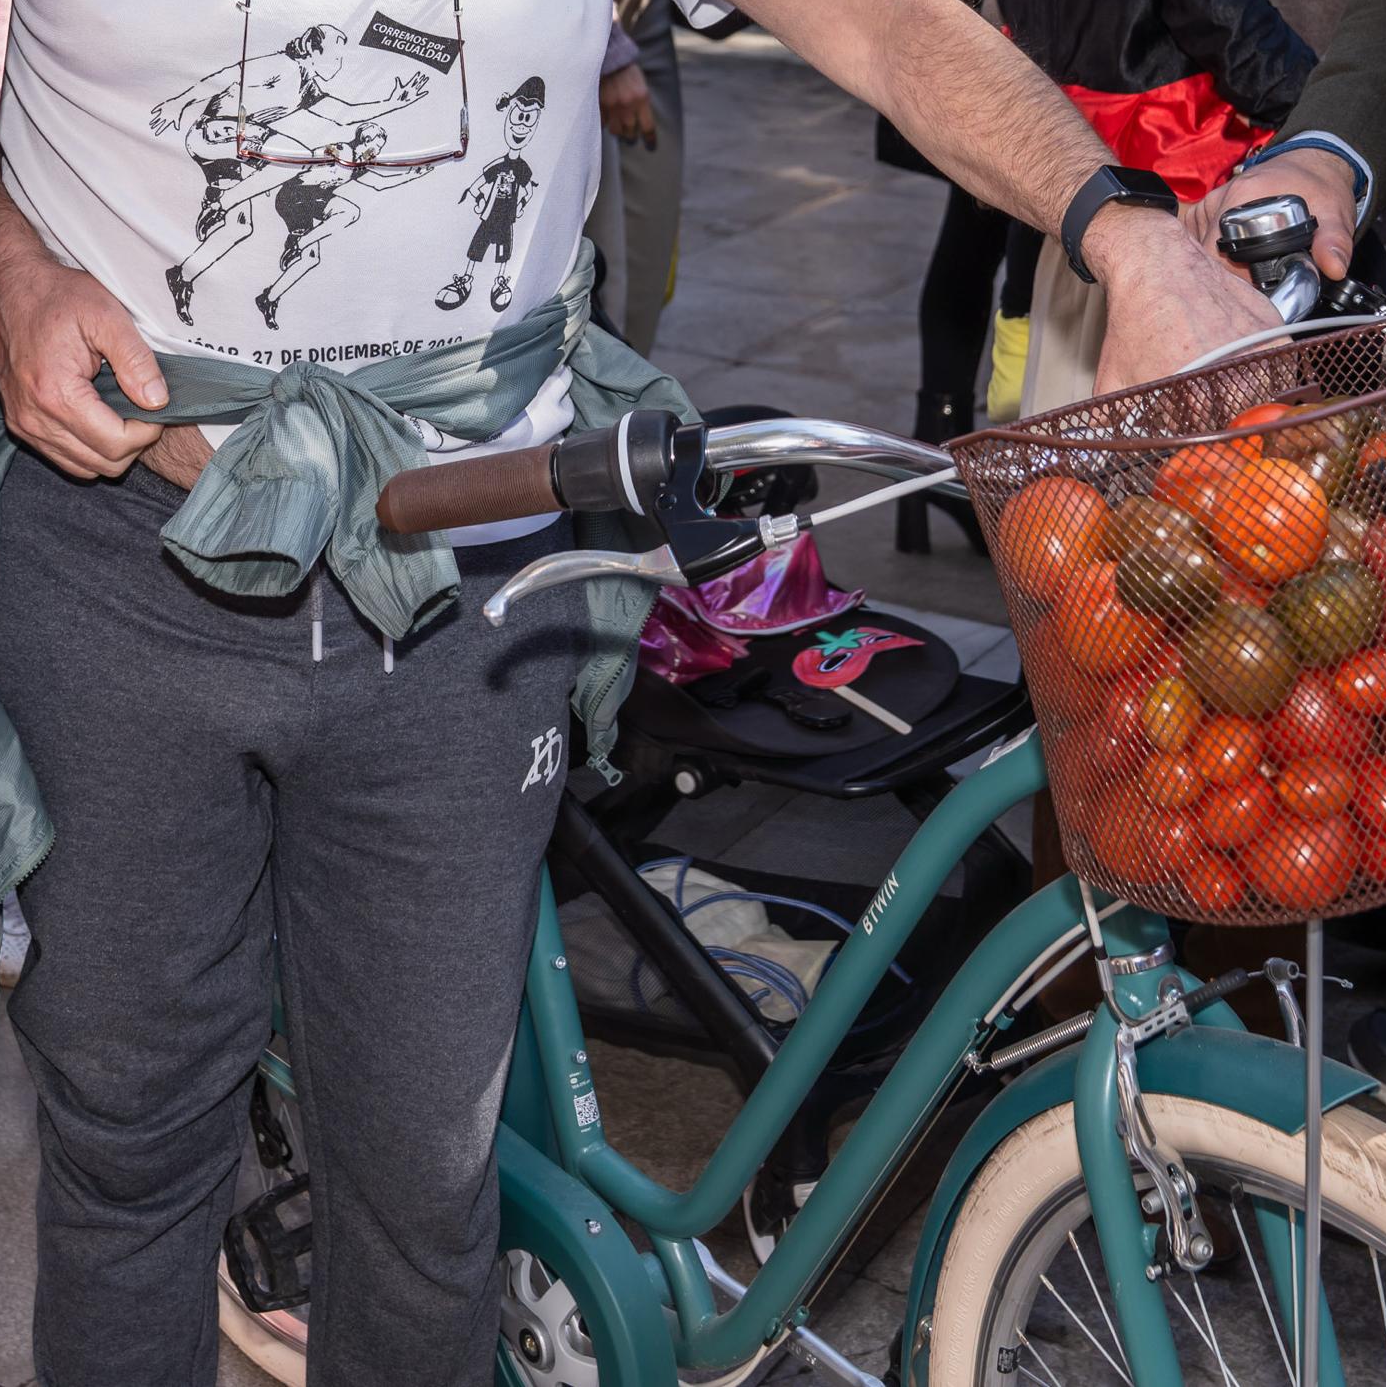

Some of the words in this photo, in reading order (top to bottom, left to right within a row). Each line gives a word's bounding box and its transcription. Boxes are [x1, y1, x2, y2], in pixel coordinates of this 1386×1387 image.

[372, 22, 428, 46] CORREMOS
[426, 40, 446, 51] por
[380, 36, 392, 47] la
[392, 39, 451, 63] IGUALDAD
[253, 350, 273, 365] 27
[281, 349, 302, 365] DE
[308, 340, 401, 363] DICIEMBRE
[403, 339, 424, 354] DE
[862, 871, 899, 936] BTWIN
